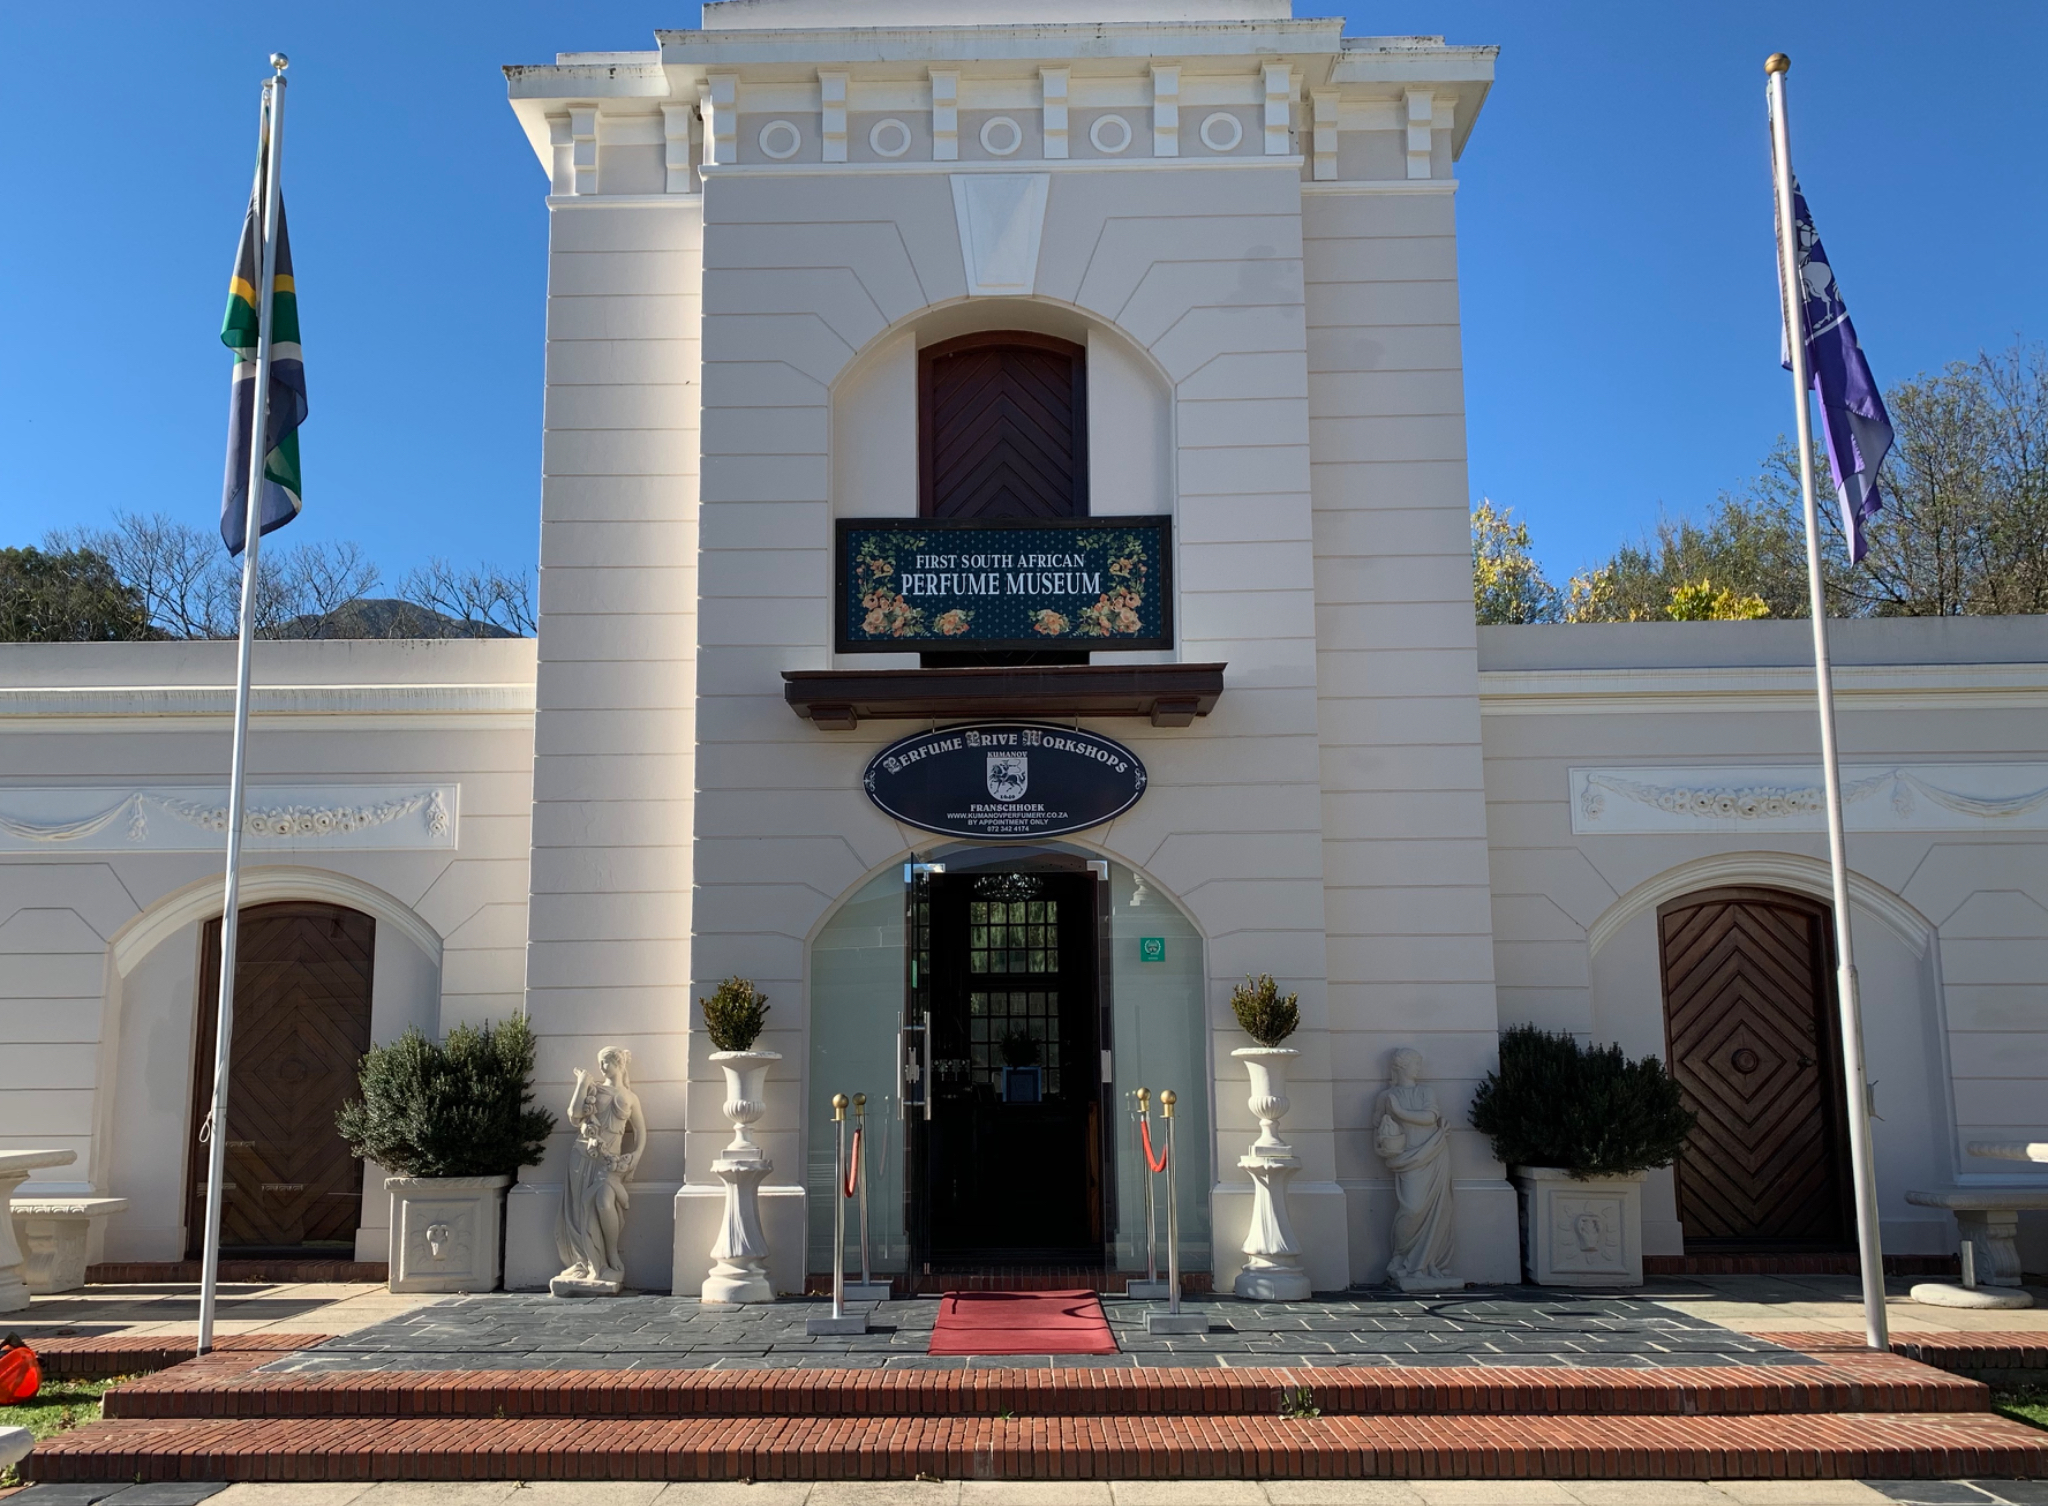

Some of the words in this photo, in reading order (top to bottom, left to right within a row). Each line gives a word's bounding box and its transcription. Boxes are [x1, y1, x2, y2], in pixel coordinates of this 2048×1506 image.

[915, 554, 957, 569] FIRST
[961, 554, 1012, 569] SOUTH
[1017, 553, 1085, 568] AFRICAN
[901, 573, 1000, 595] PERFUME
[1006, 572, 1100, 595] MUSEUM
[882, 737, 963, 775] PERFUME
[965, 730, 1018, 747] PRIVE
[1022, 729, 1129, 774] WORKSHOPS
[970, 804, 1045, 812] FRANSCHHOEK
